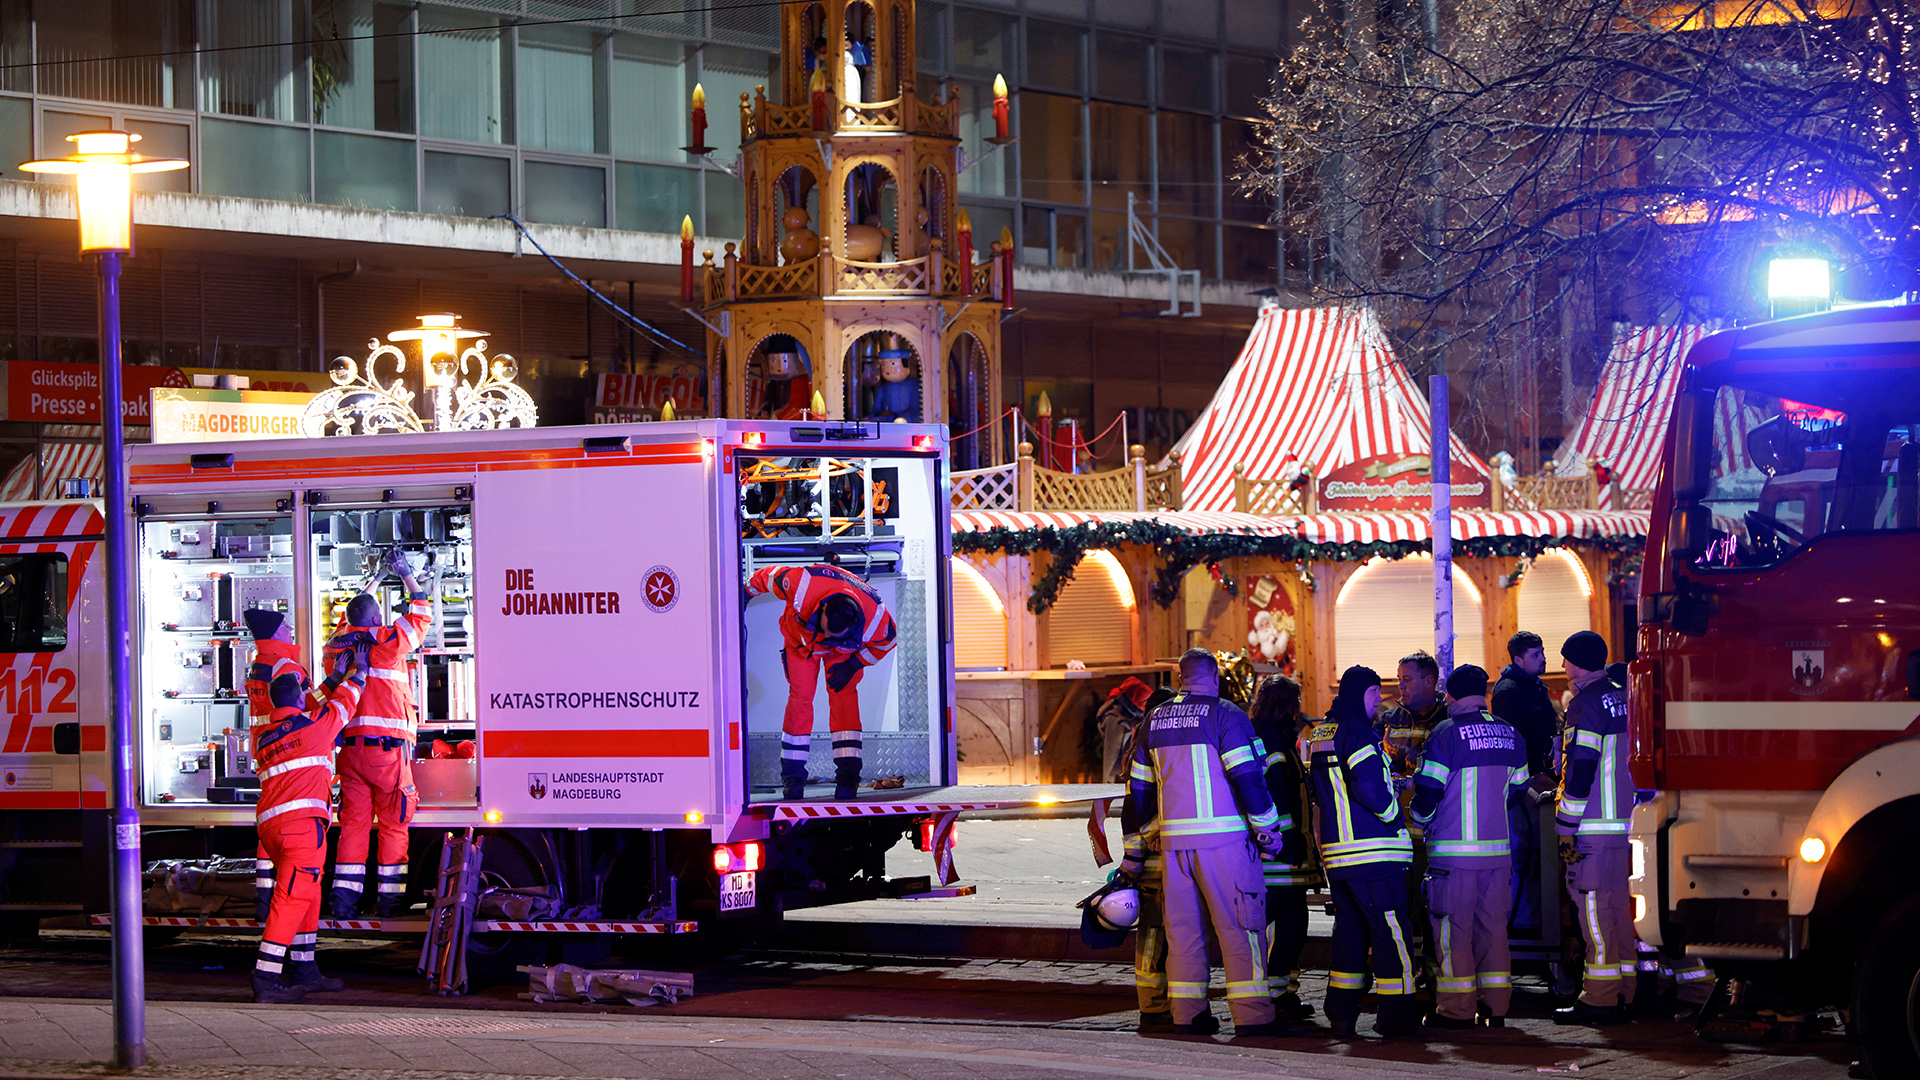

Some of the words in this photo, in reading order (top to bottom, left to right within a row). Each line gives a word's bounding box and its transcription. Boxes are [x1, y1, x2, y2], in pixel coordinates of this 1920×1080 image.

[31, 369, 98, 391] Glückspilz
[31, 393, 86, 415] Presse
[182, 413, 299, 435] MAGDEBURGER
[506, 569, 534, 590] DIE
[502, 592, 620, 615] JOHANNITER
[0, 667, 77, 714] 112
[490, 691, 700, 709] KATASTROPHENSCHUTZ
[552, 773, 664, 783] LANDESHAUPTSTADT
[552, 789, 622, 799] MAGDEBURG
[732, 875, 742, 890] MD
[722, 893, 732, 908] KS
[734, 890, 753, 907] 8007
